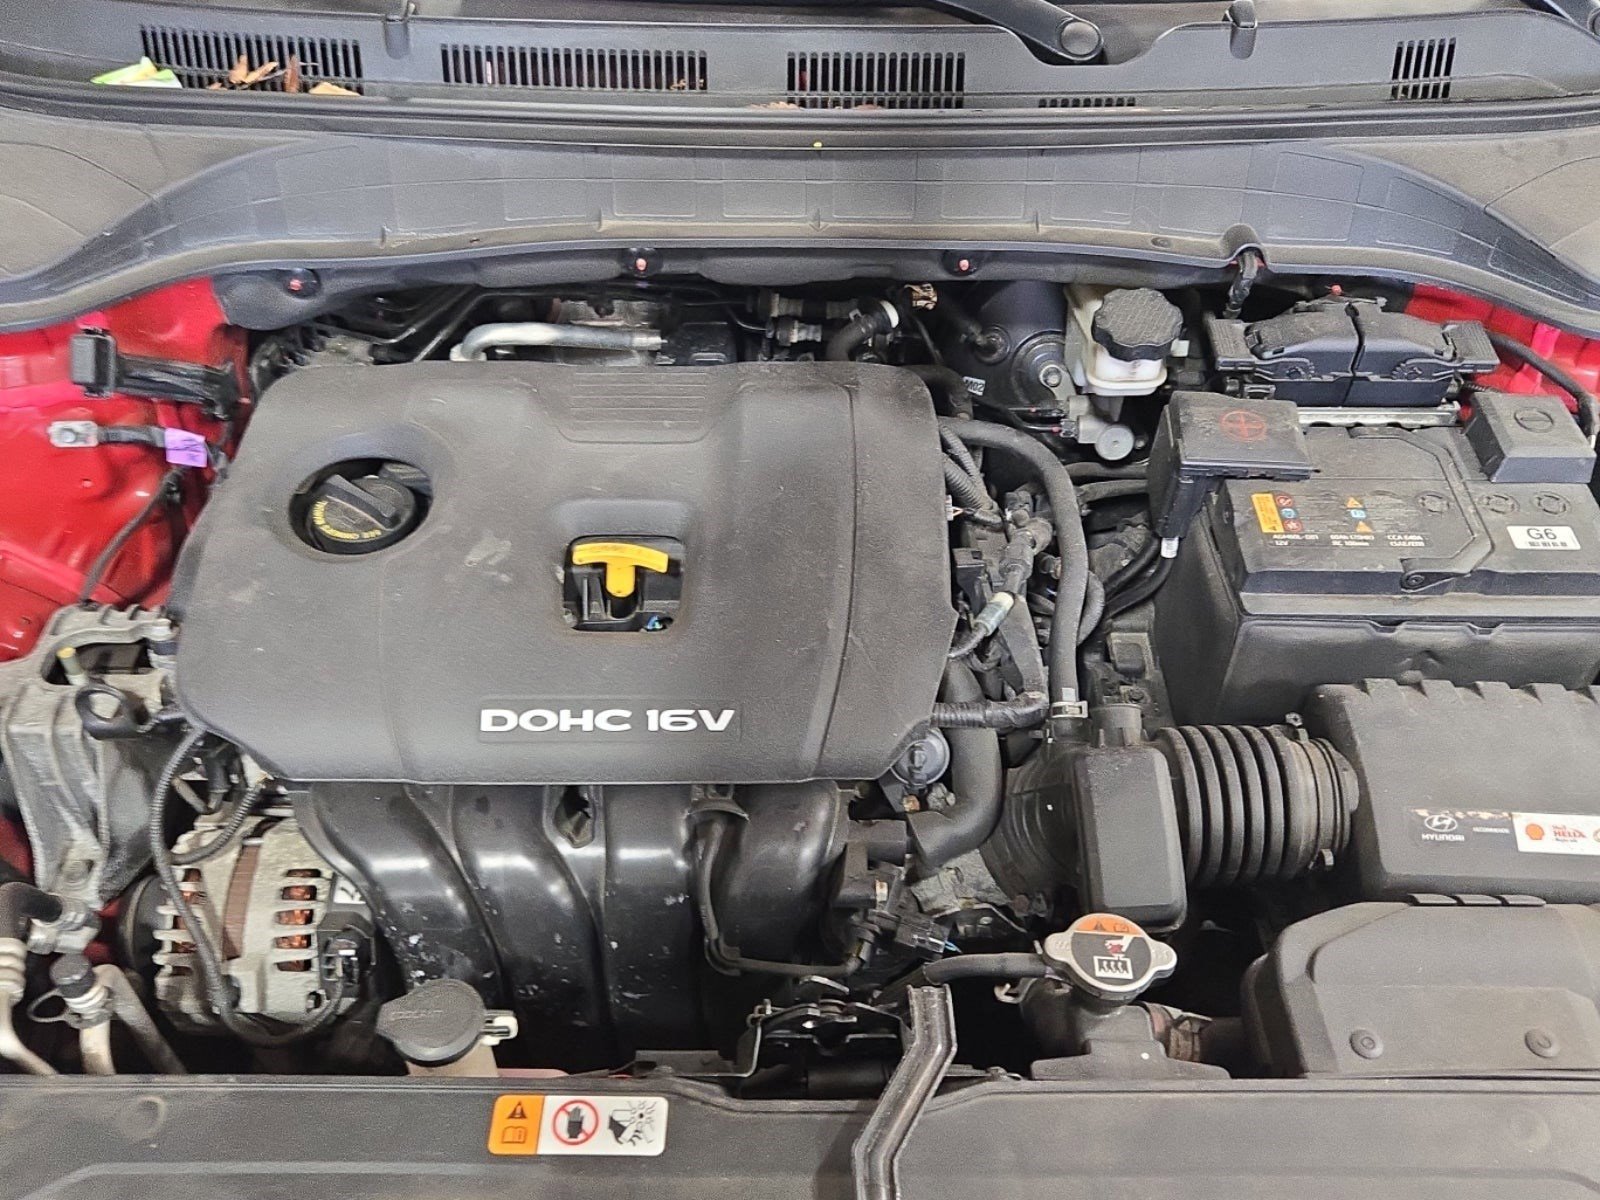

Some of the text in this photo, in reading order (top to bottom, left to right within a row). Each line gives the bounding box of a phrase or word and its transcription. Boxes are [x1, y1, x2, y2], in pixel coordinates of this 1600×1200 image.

[1526, 528, 1557, 540] G6
[480, 709, 735, 732] DOHC 16V
[1421, 833, 1465, 842] HYUNDAI
